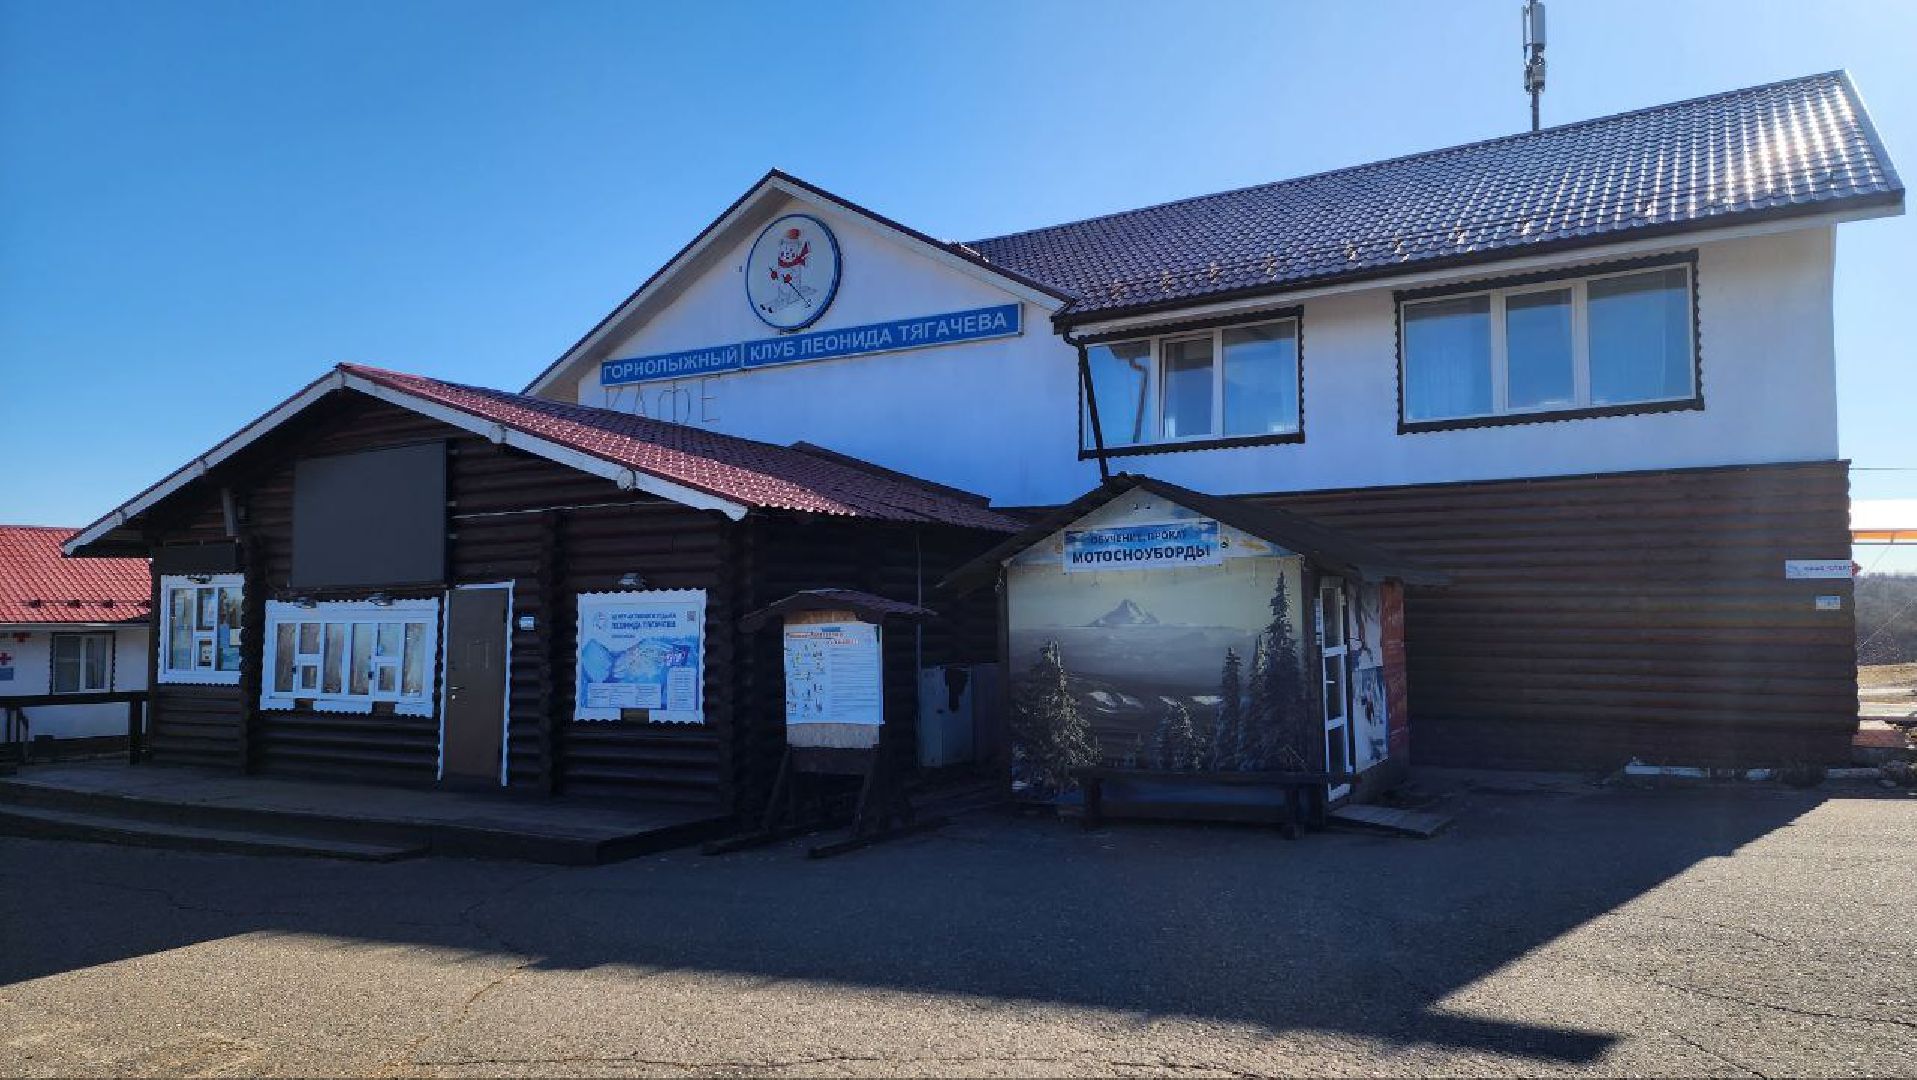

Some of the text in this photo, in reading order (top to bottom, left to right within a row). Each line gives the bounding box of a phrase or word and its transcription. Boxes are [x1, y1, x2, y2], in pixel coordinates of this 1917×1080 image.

[603, 312, 1008, 380] ГОРНОЛЫЖНЫЙ КЛУБ ЛЕОНИДА ТЯГАЧЕВА
[1072, 545, 1211, 564] МОТОСНОУБОРДЫ
